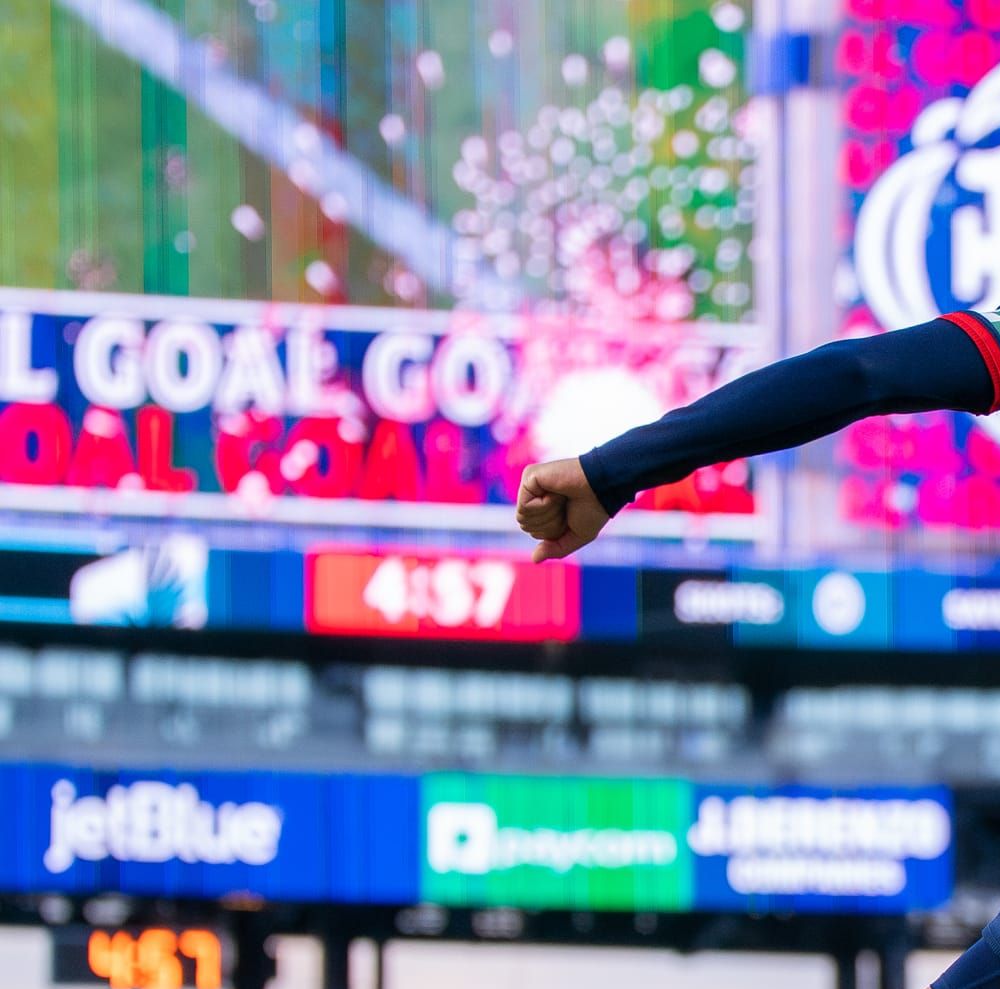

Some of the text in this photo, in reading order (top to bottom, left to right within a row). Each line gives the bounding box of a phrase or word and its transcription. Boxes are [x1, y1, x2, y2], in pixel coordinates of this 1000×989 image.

[73, 315, 364, 420] GOAL
[362, 330, 512, 426] GO
[0, 402, 197, 493] OAL
[363, 554, 516, 628] 4:57
[43, 778, 284, 874] jetBlue
